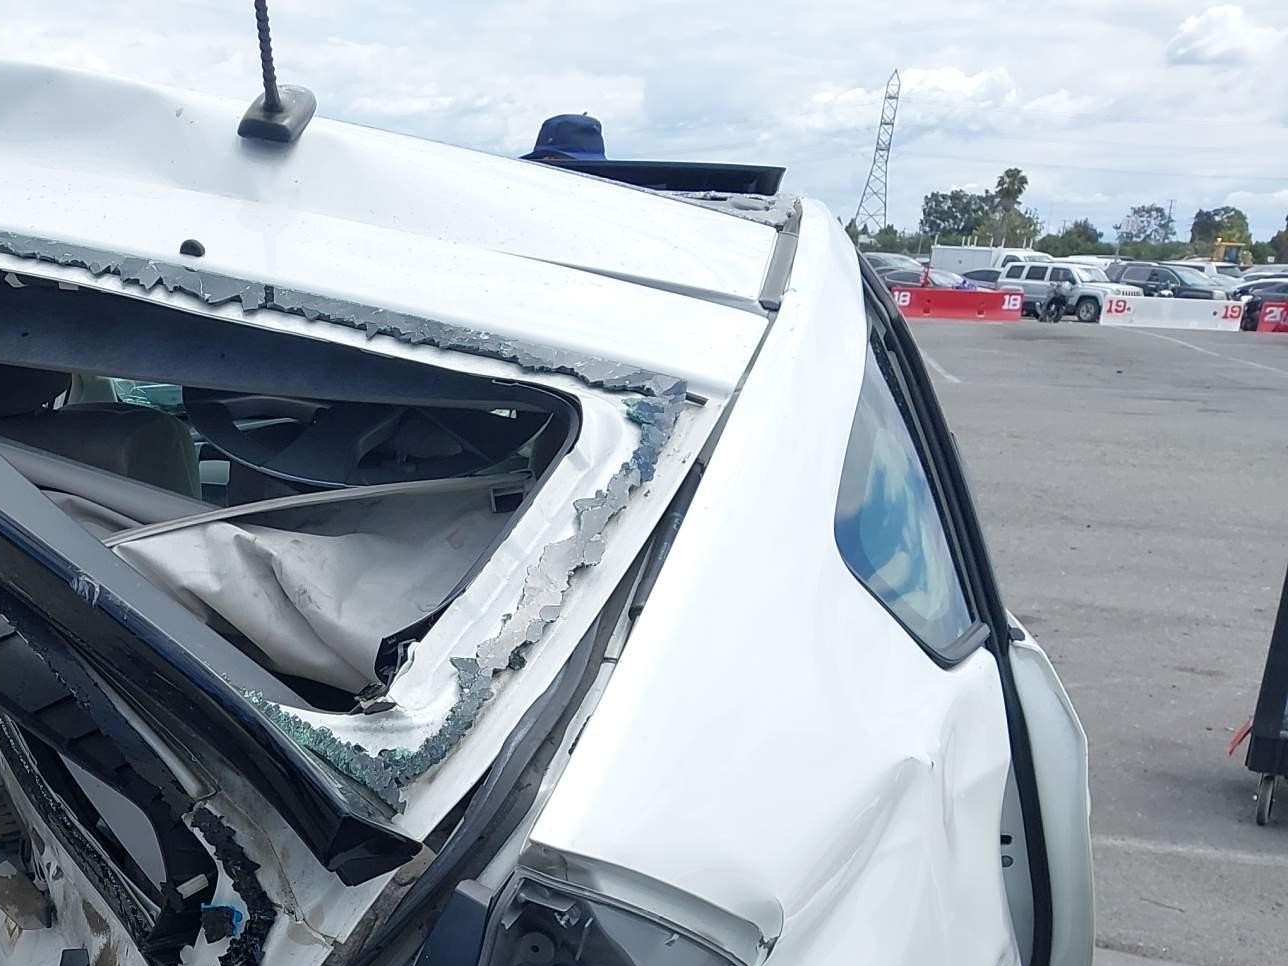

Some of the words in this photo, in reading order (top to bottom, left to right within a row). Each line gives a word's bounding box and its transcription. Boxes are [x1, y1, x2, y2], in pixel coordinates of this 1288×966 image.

[1002, 294, 1022, 310] 18
[1106, 299, 1127, 314] 19
[1221, 304, 1242, 320] 19
